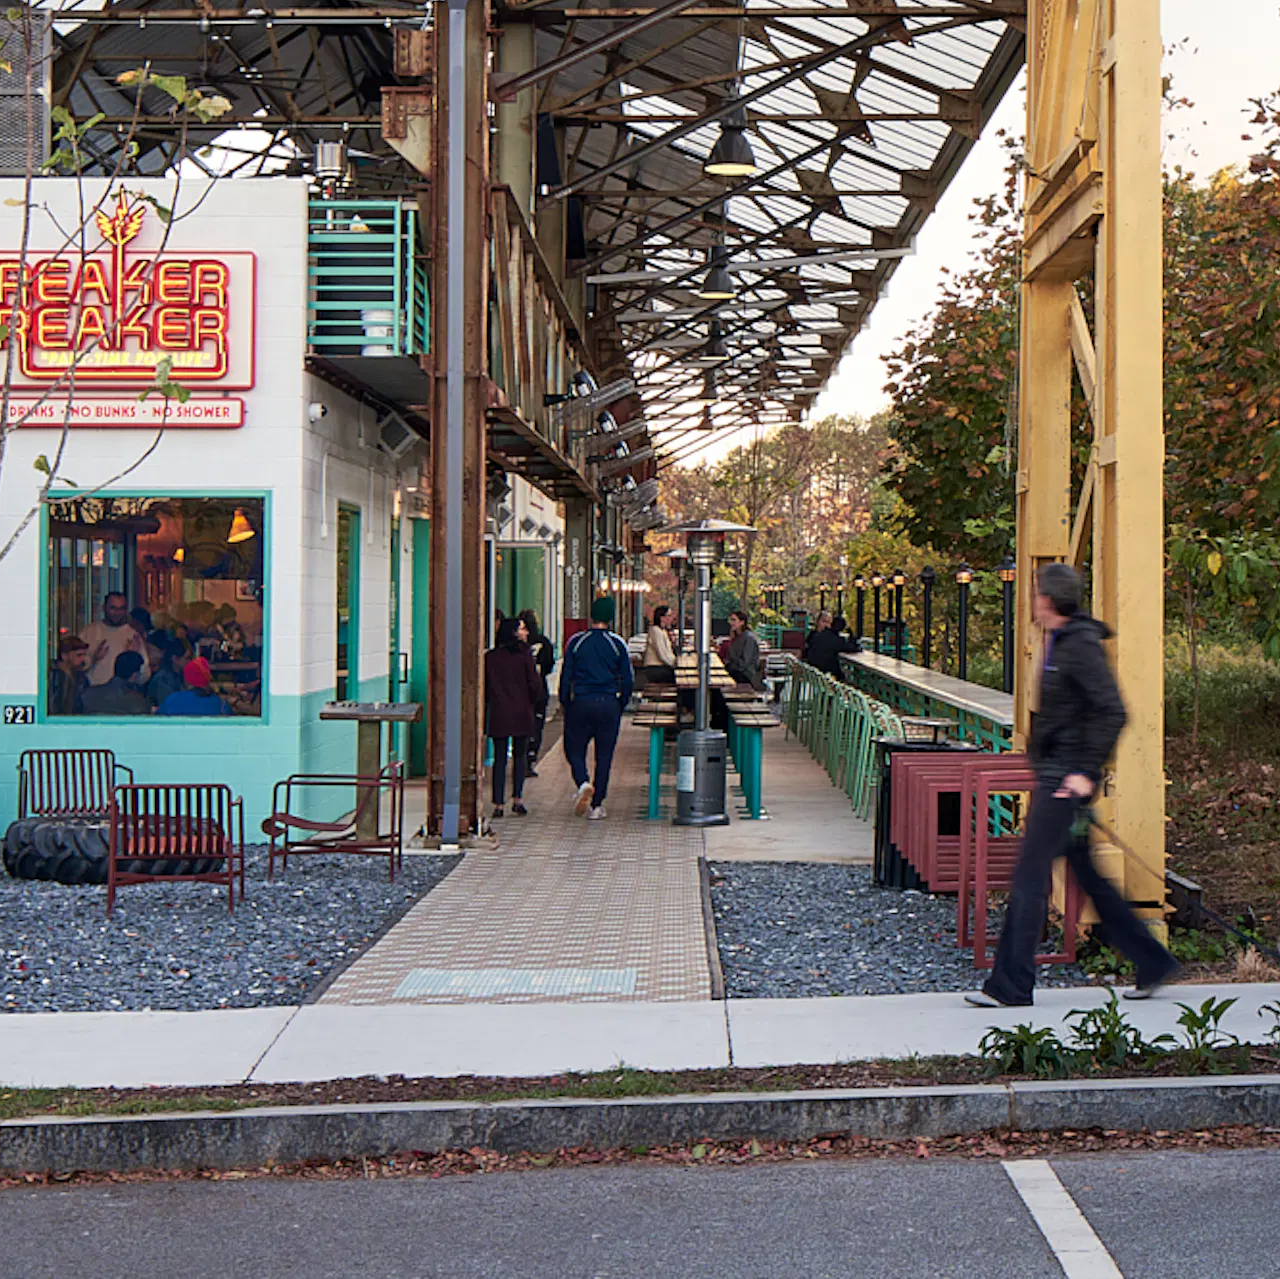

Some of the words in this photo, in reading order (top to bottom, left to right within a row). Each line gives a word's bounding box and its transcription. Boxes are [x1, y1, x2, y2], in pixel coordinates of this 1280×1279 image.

[70, 406, 92, 418] NO
[96, 406, 136, 417] BUNKS
[152, 406, 174, 417] NO
[176, 406, 231, 417] SHOWER
[5, 706, 33, 723] 921
